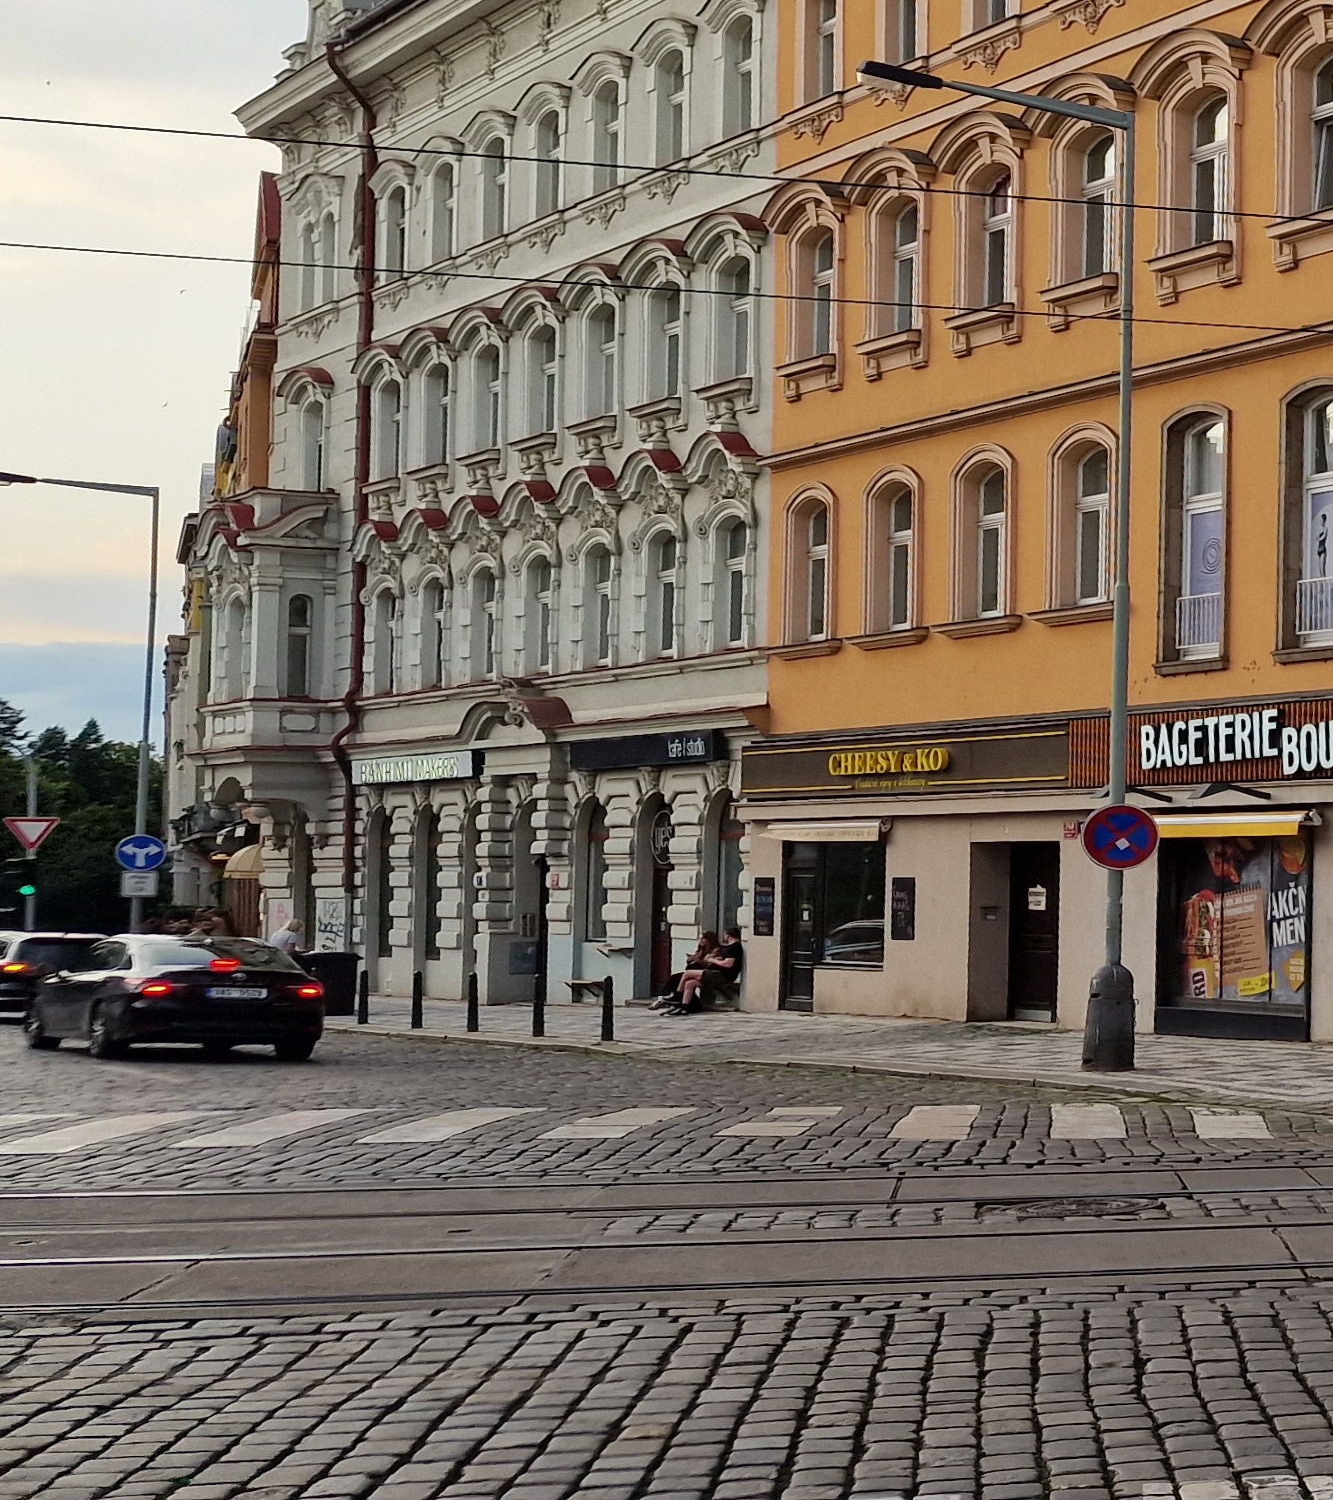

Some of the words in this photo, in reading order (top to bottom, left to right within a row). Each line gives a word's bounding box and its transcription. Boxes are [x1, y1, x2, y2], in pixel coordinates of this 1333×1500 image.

[828, 750, 900, 776] CHEESY
[902, 753, 917, 772] &
[916, 747, 945, 772] KO
[1140, 708, 1279, 770] BAGETERIE
